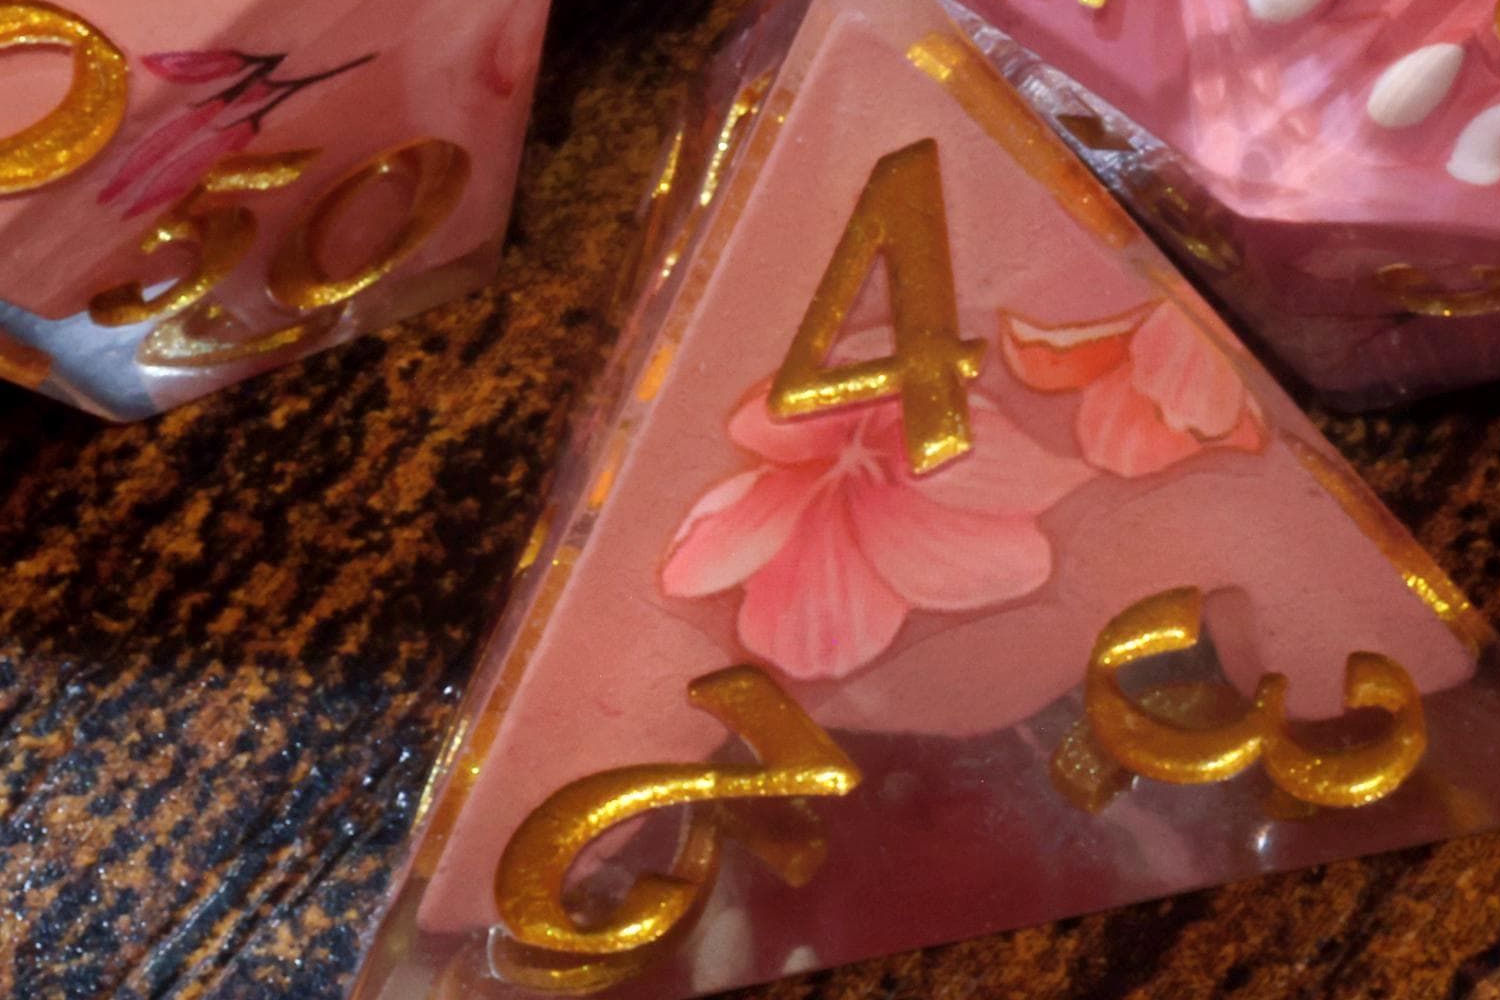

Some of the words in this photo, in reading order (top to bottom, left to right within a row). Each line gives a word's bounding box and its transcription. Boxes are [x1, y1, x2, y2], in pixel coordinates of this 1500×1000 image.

[766, 136, 988, 475] 4
[493, 663, 862, 954] 2
[1082, 585, 1430, 809] 3
